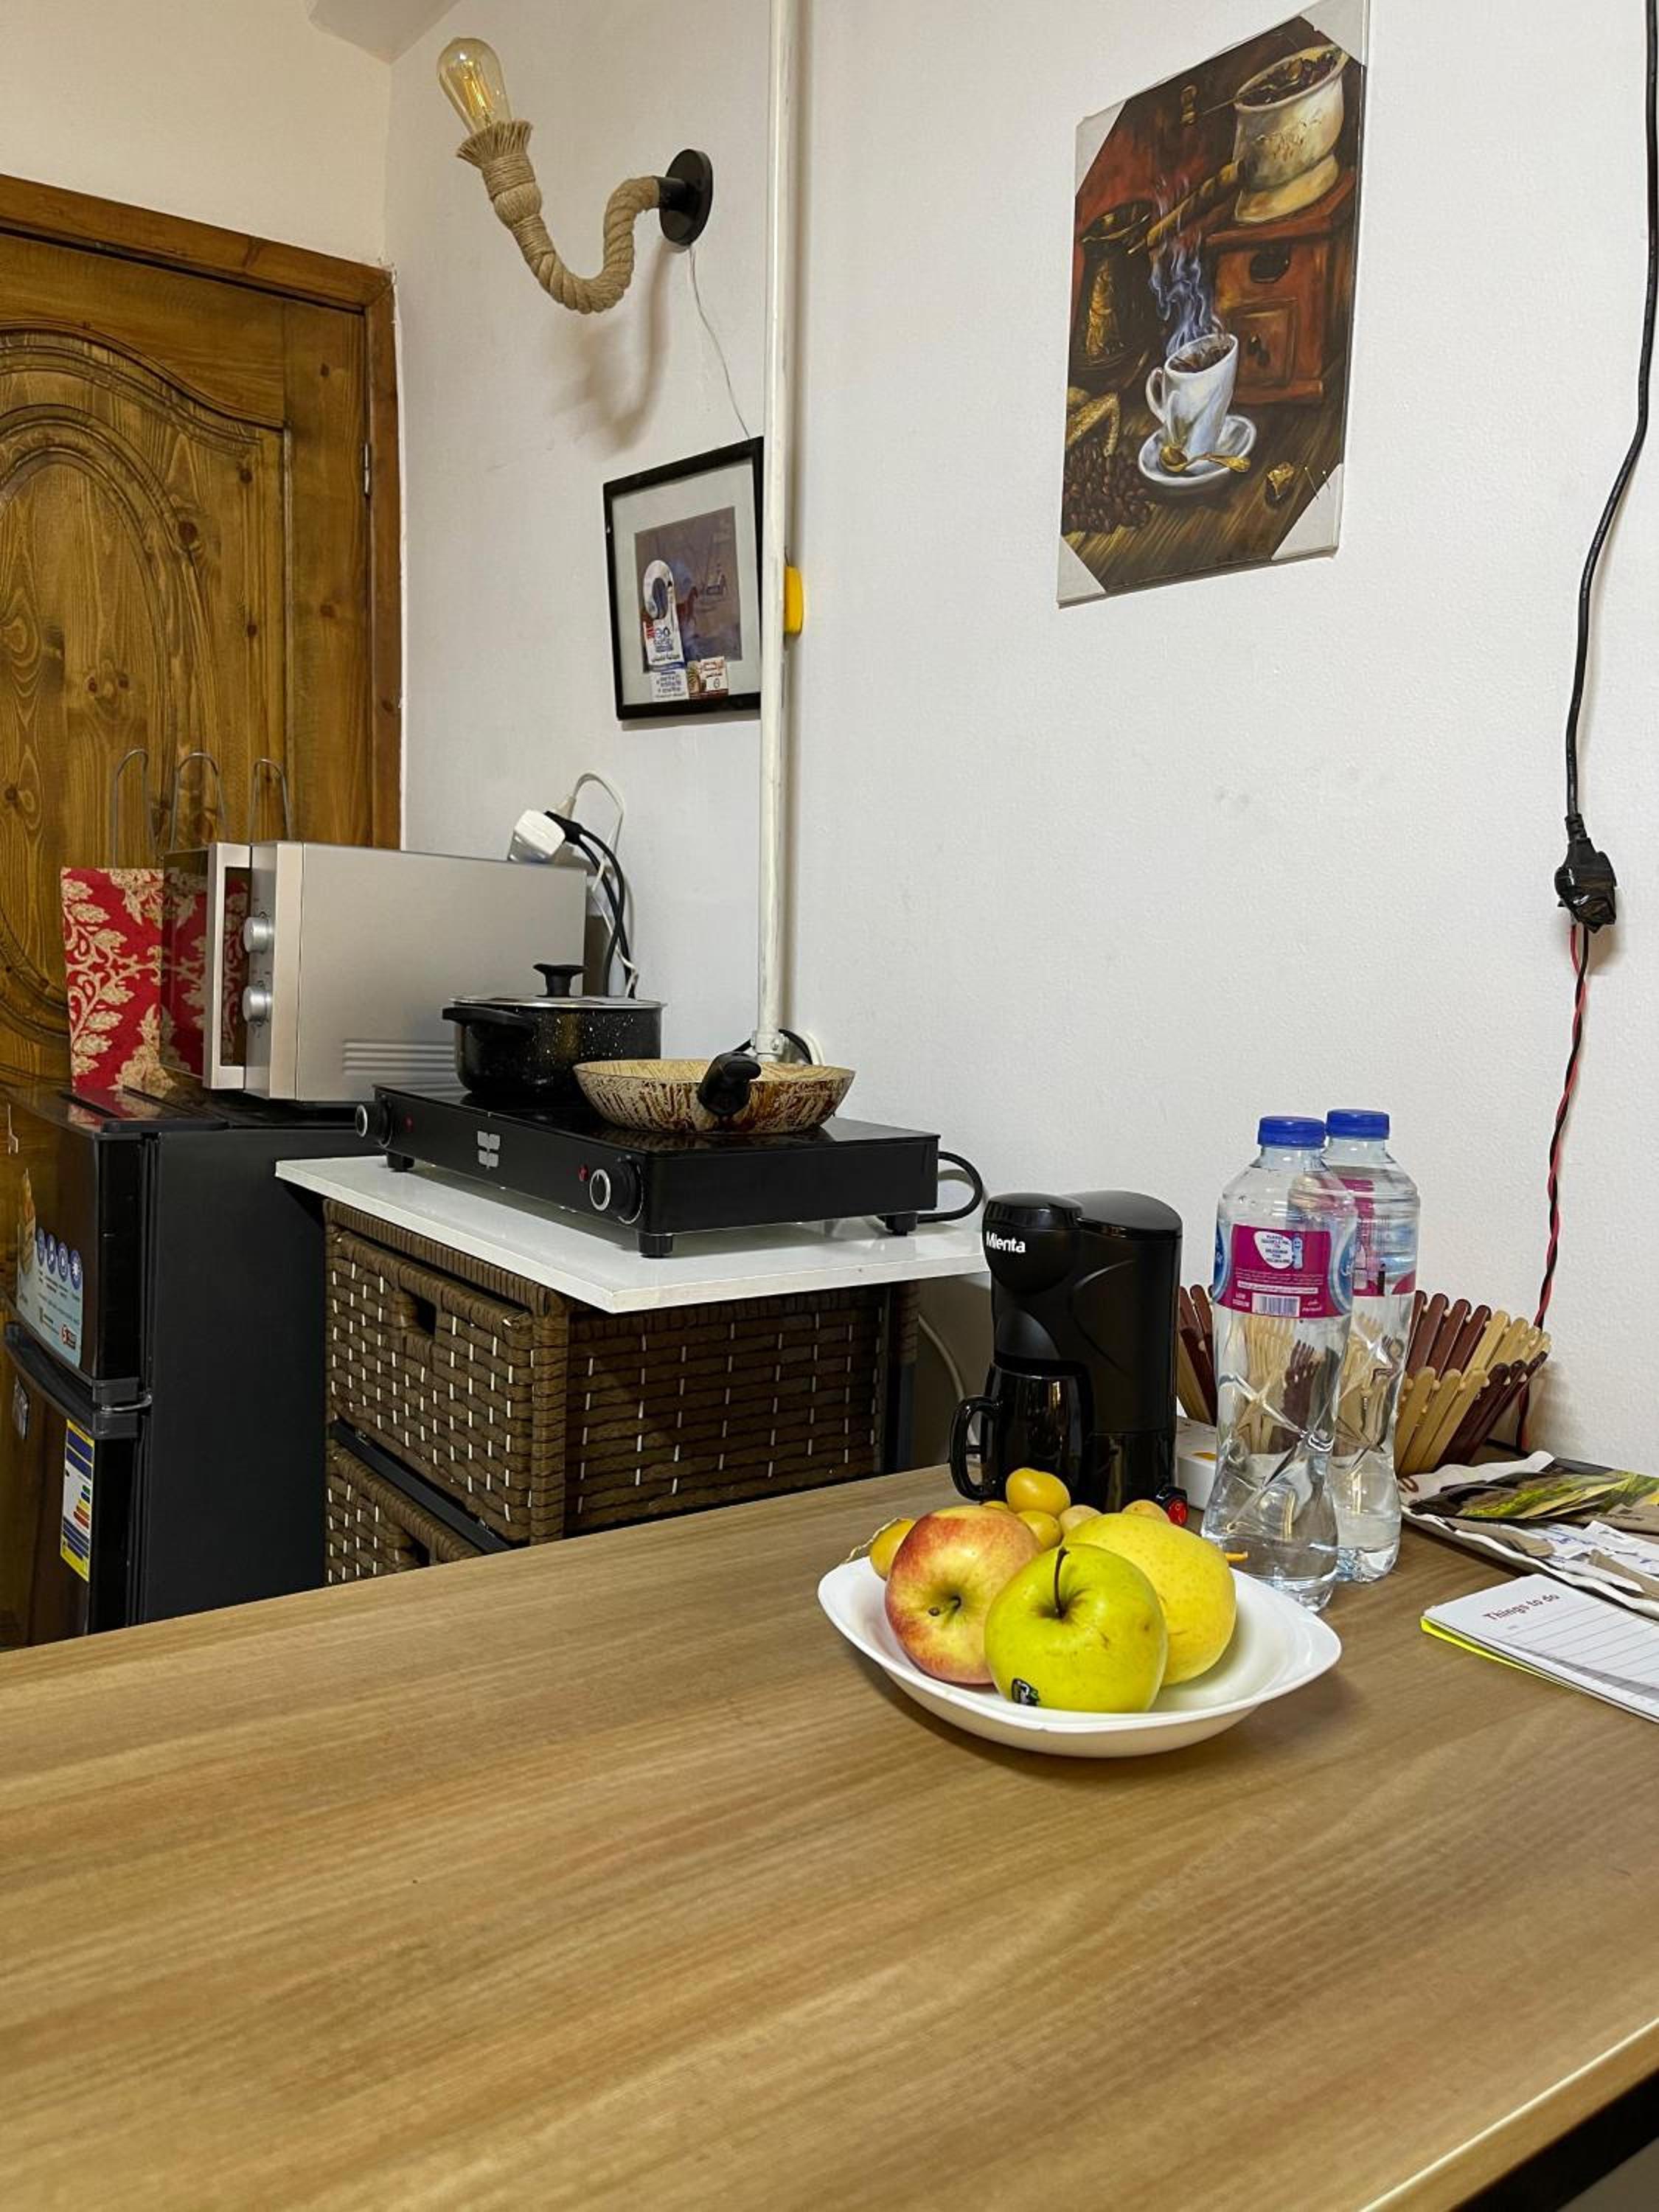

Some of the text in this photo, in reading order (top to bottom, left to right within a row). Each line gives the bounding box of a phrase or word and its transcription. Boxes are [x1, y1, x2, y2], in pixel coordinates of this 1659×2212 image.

[986, 1231, 1026, 1253] Mienta
[1482, 1604, 1530, 1619] Things
[1543, 1594, 1560, 1602] do
